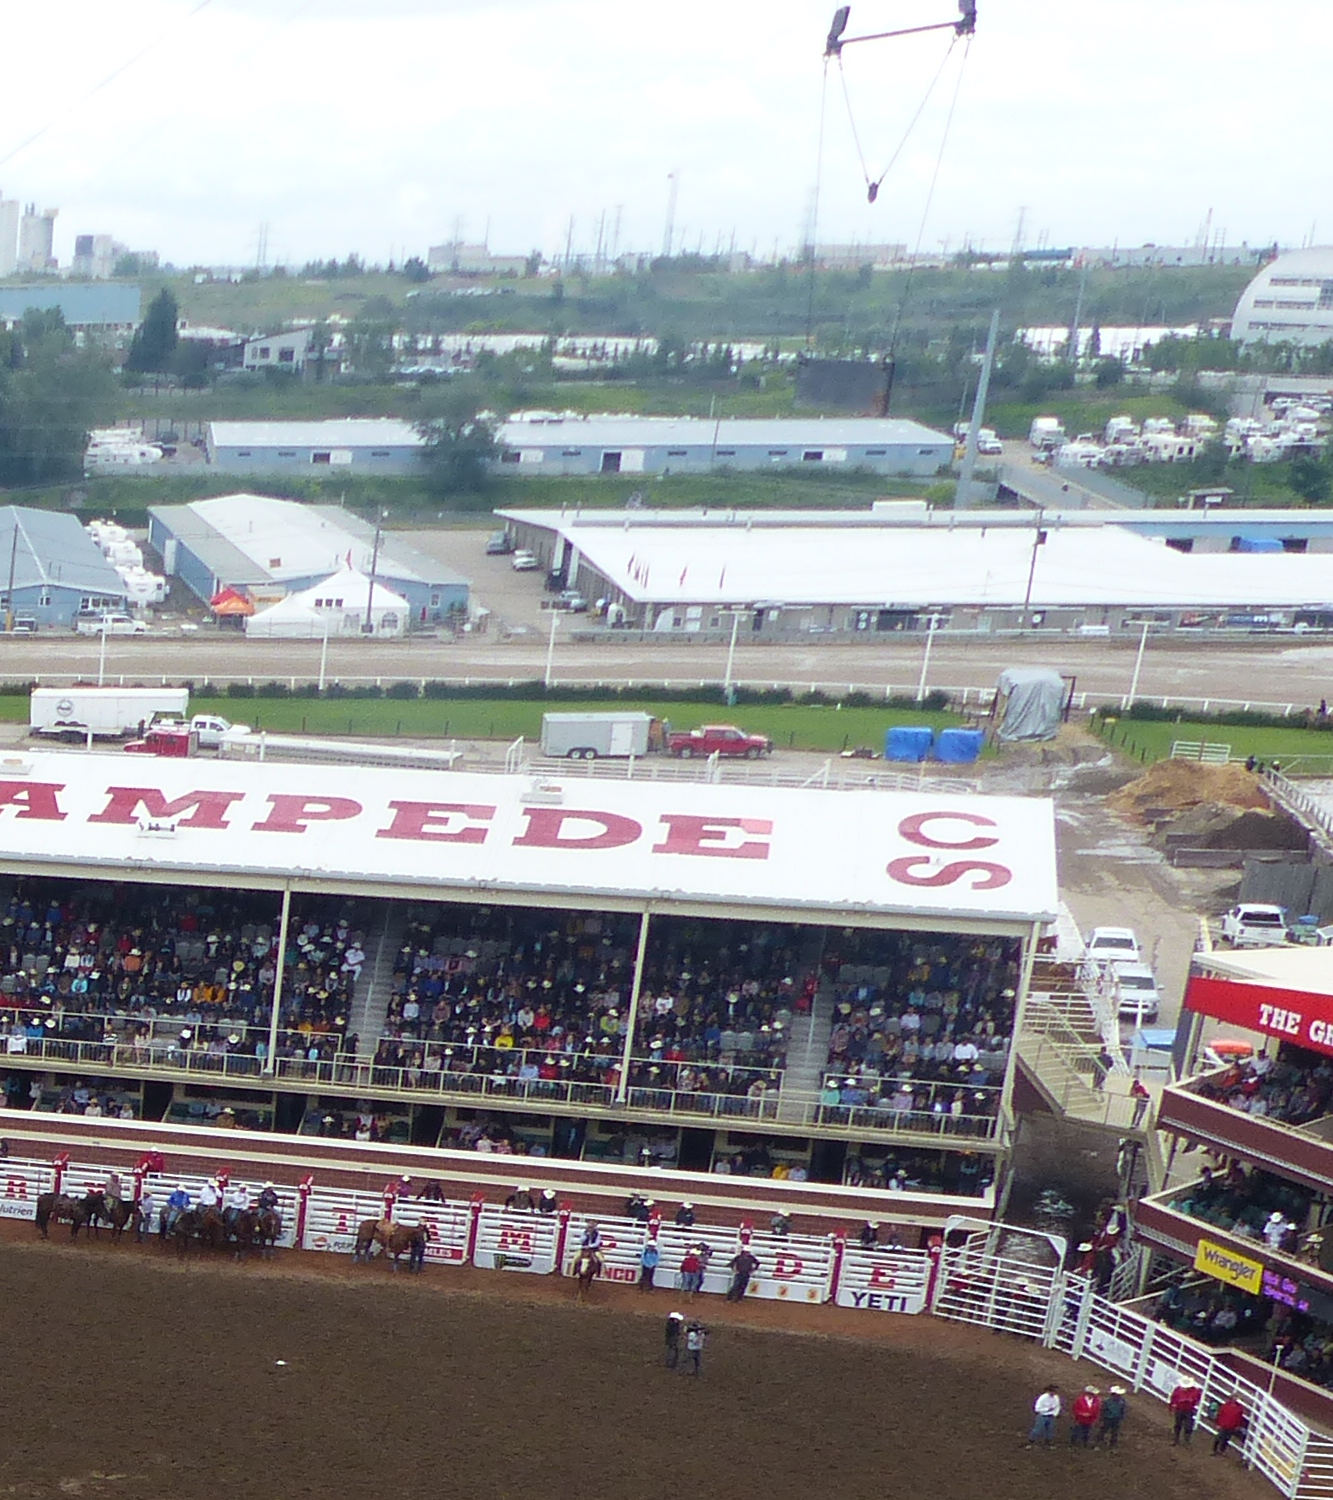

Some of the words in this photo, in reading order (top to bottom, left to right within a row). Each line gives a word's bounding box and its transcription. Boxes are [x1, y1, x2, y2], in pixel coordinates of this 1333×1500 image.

[1259, 1003, 1302, 1035] THE
[1204, 1246, 1256, 1280] Wrangler
[851, 1291, 907, 1312] YETI
